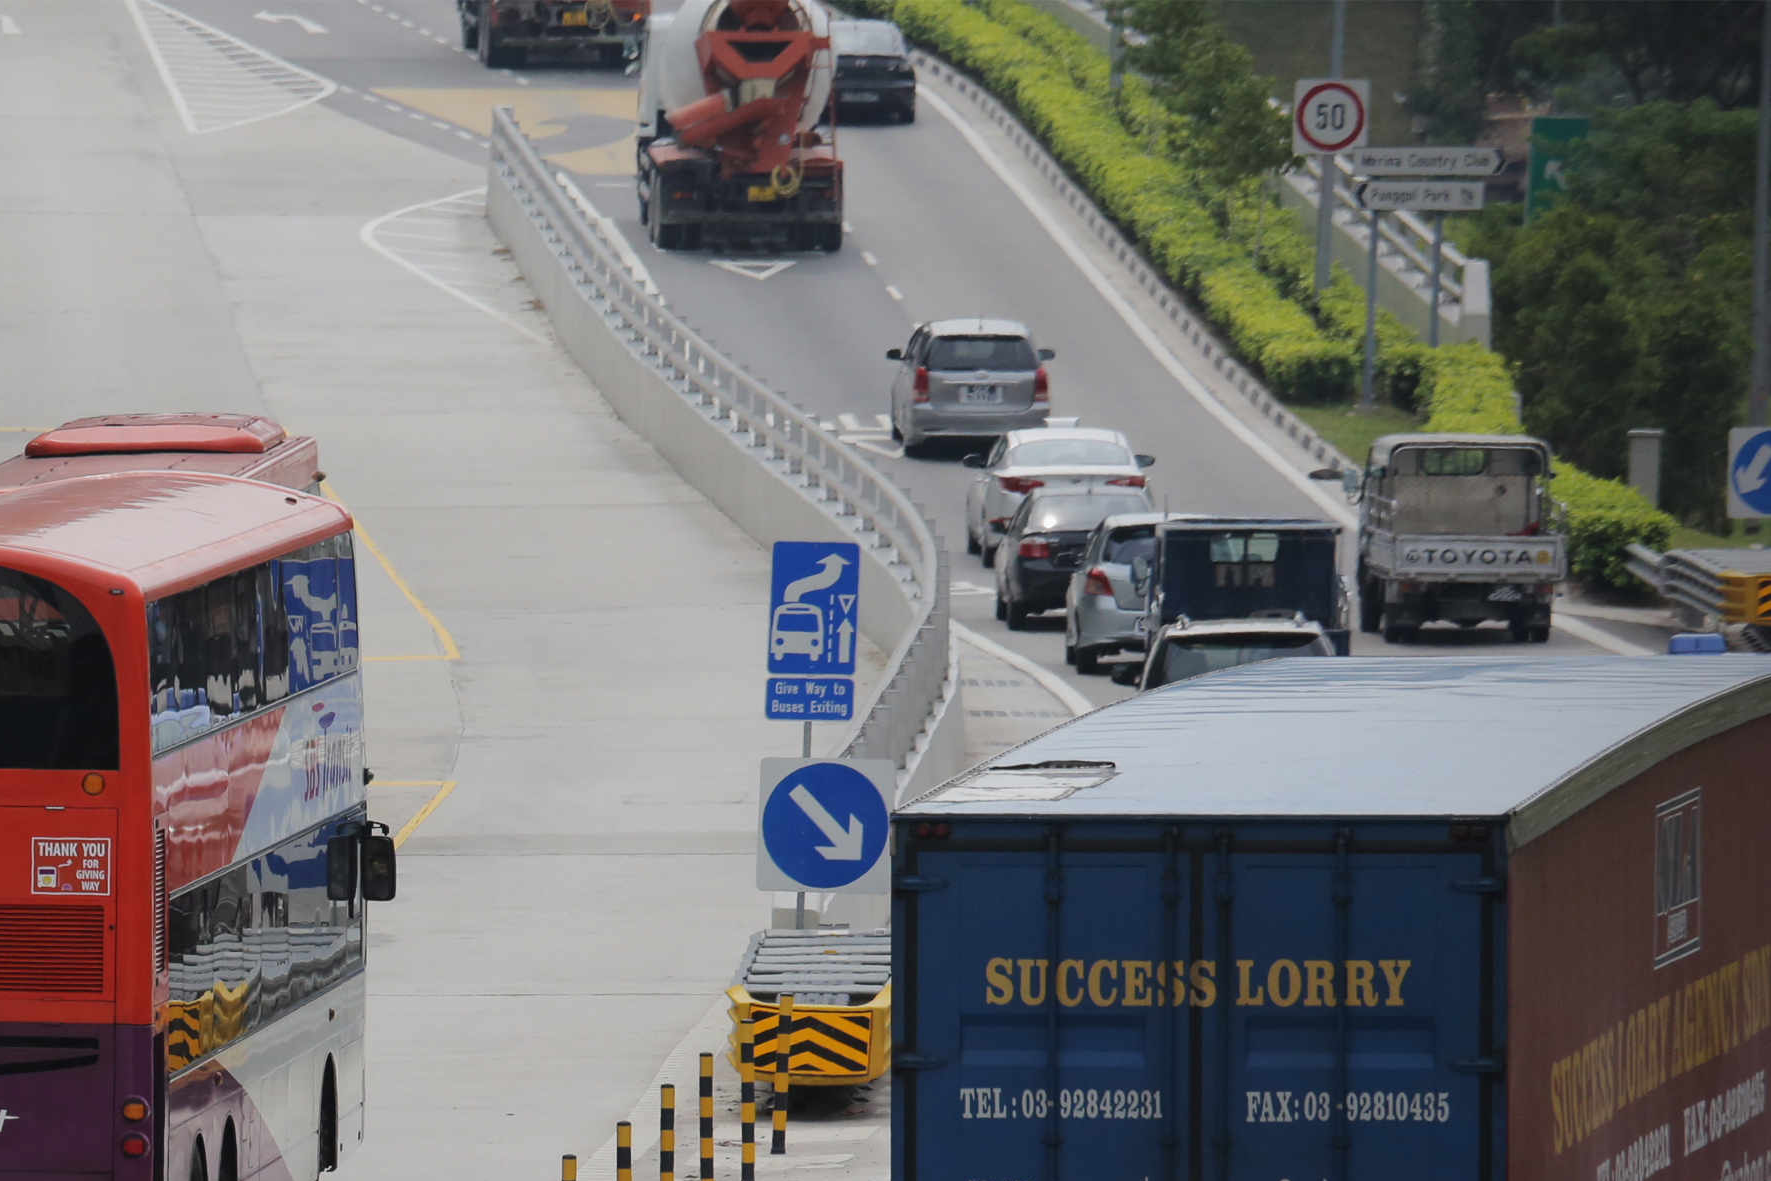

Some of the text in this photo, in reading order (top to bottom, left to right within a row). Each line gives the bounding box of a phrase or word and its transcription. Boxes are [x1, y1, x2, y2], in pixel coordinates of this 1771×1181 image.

[1315, 103, 1345, 131] 50
[1360, 154, 1490, 170] Marina Country Club
[1370, 189, 1450, 205] Punggol Park
[1422, 549, 1532, 565] TOYOTA
[774, 681, 846, 699] Give Way to
[771, 699, 848, 717] Buses Exiting
[37, 841, 106, 858] THANK YOU
[82, 858, 99, 869] FOR
[75, 869, 105, 880] GIVING
[81, 880, 100, 892] WAY
[985, 956, 1412, 1008] SUCCESS LORRY
[1550, 1027, 1615, 1155] SUCCESS
[1616, 994, 1670, 1111] LORRY
[1671, 959, 1739, 1080] AGENCY
